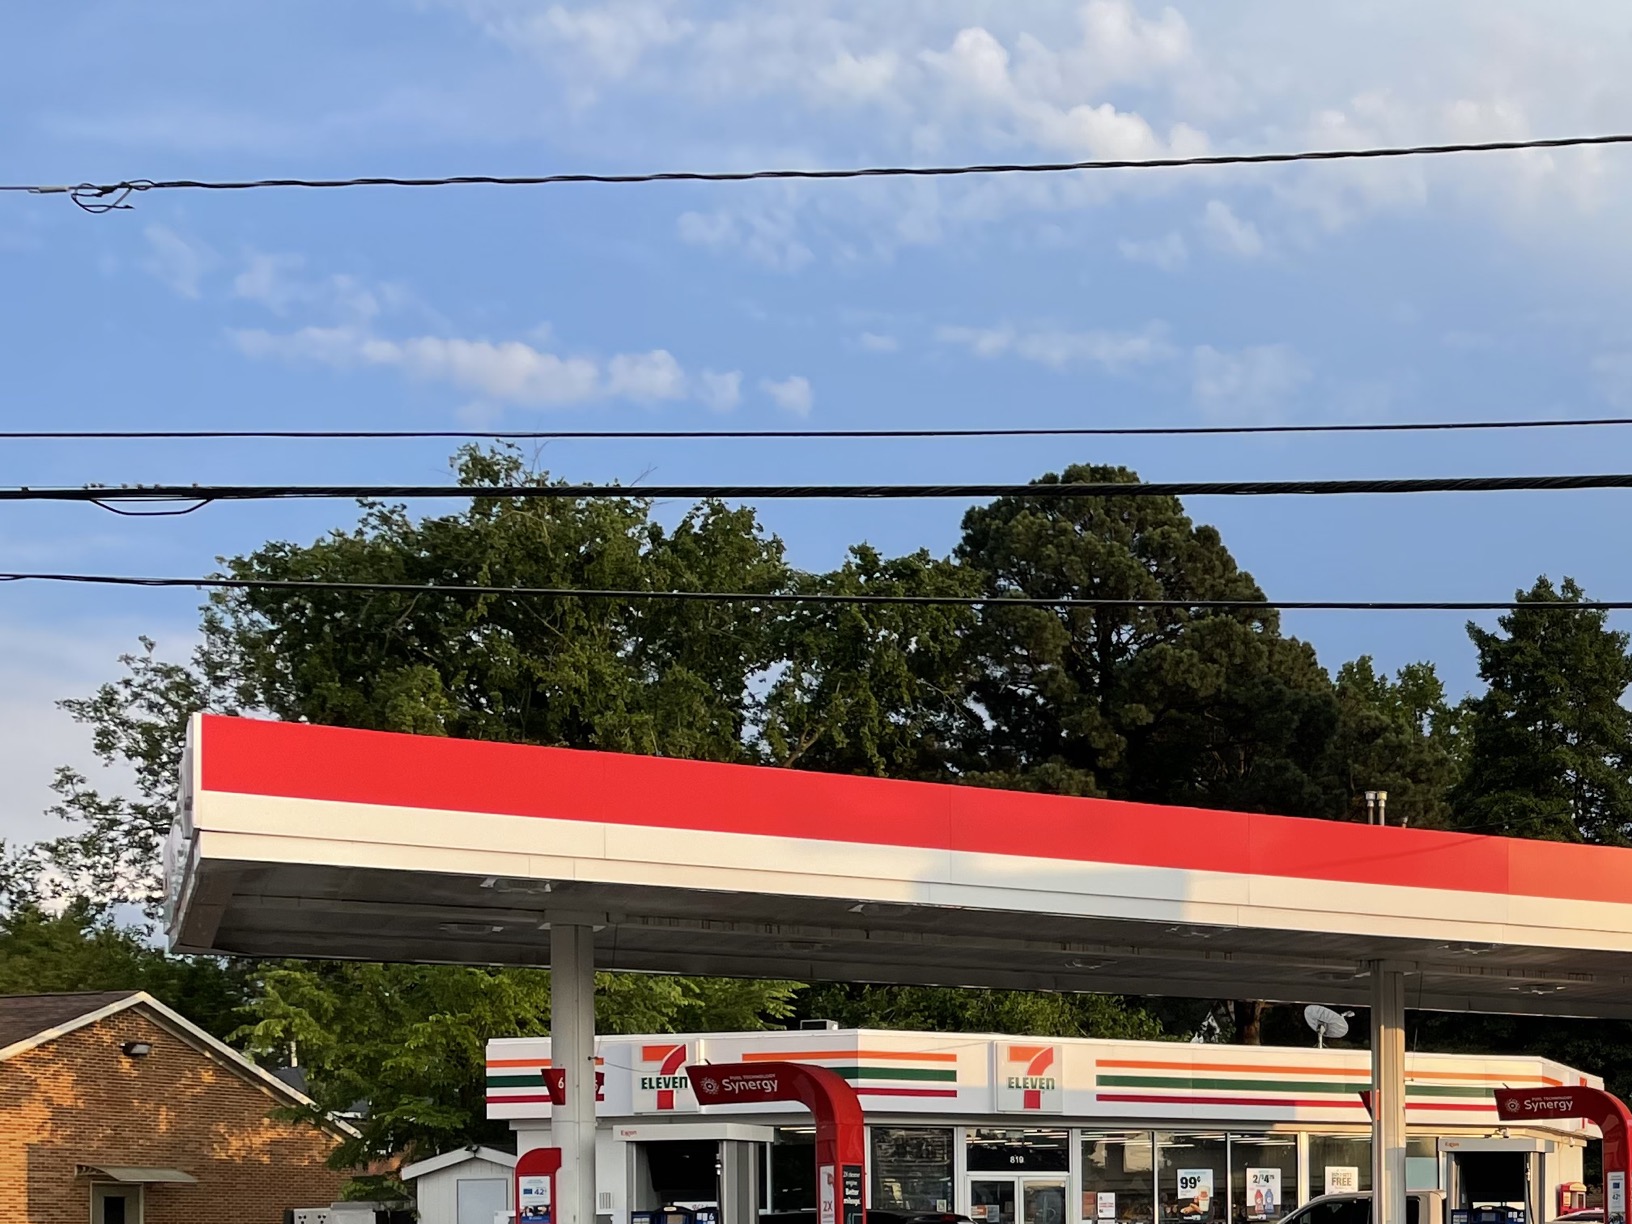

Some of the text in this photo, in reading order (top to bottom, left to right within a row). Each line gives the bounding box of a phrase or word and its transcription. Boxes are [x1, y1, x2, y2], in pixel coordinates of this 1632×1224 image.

[558, 1076, 565, 1089] 6
[722, 1078, 778, 1094] Synergy
[1523, 1099, 1573, 1112] Synergy
[1009, 1155, 1025, 1164] 819
[1331, 1177, 1352, 1186] FREE
[823, 1200, 833, 1212] 2X
[708, 1212, 715, 1221] 6
